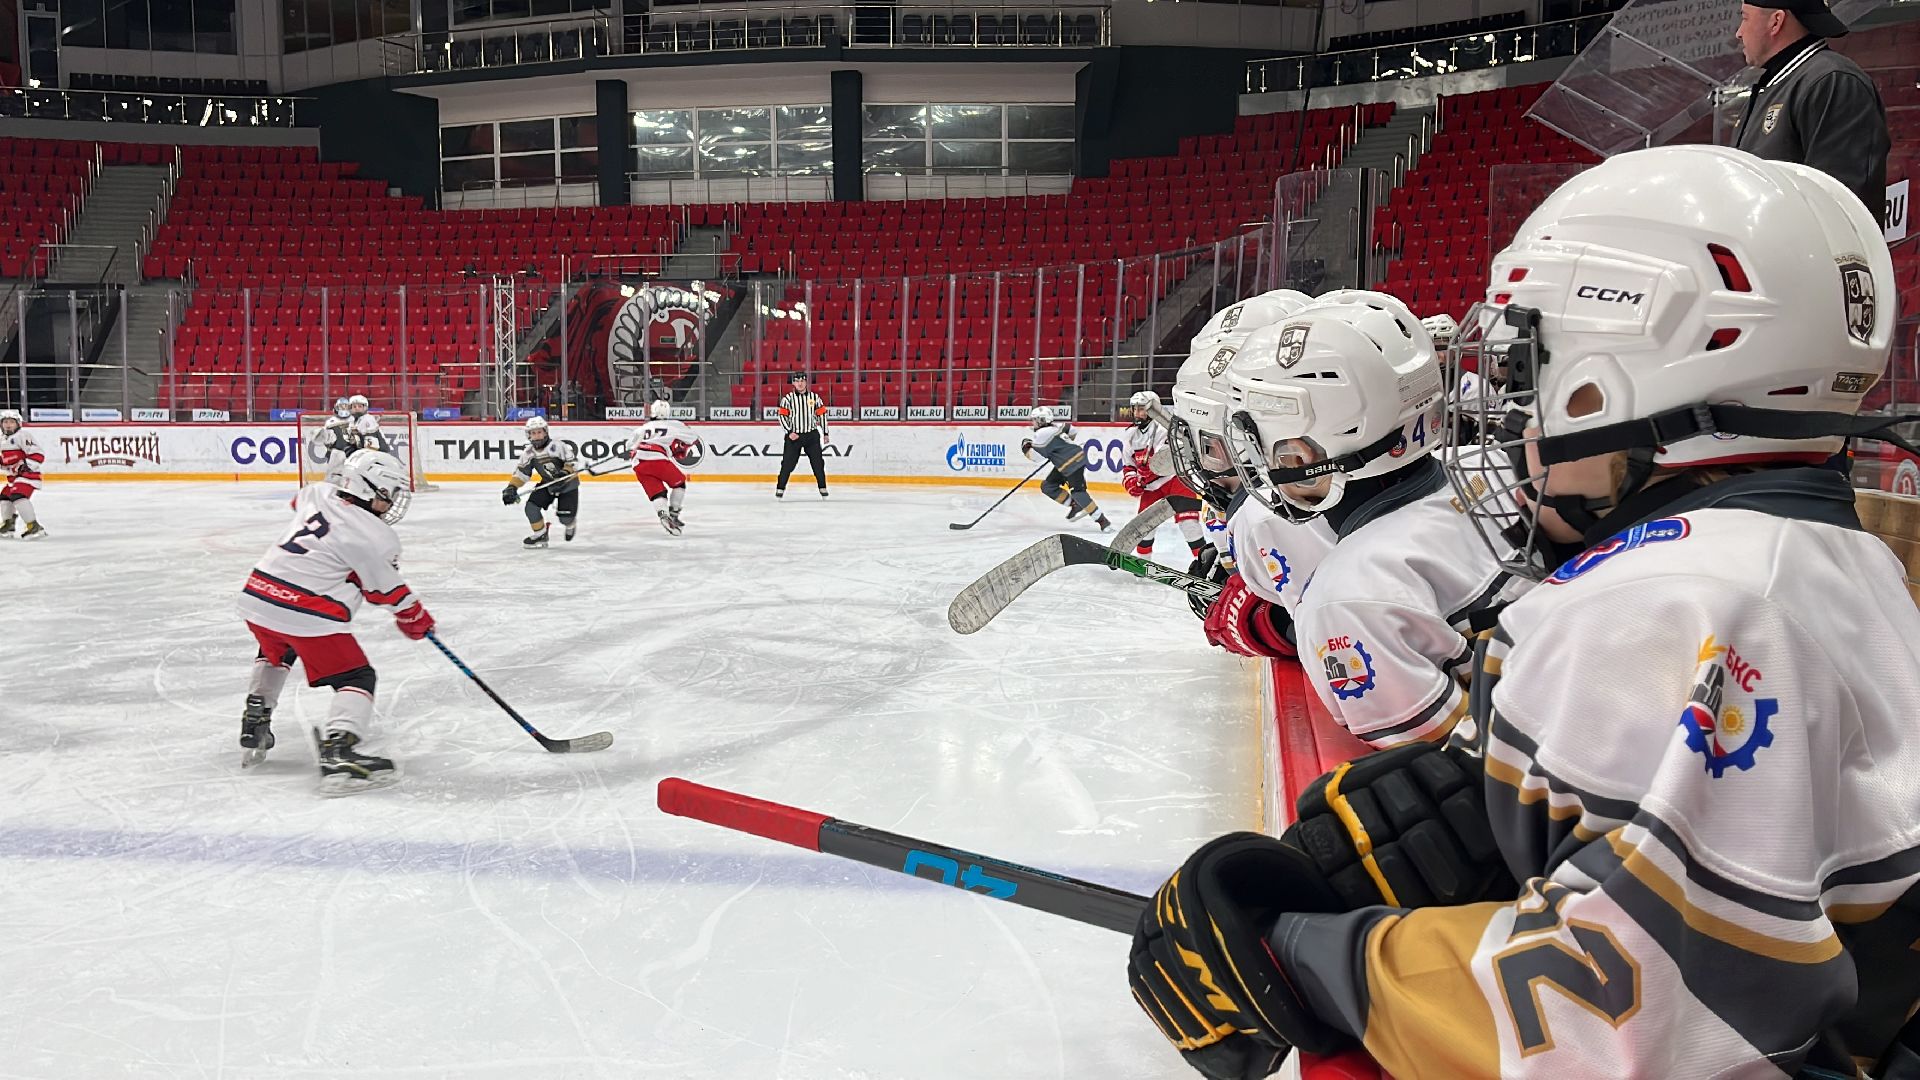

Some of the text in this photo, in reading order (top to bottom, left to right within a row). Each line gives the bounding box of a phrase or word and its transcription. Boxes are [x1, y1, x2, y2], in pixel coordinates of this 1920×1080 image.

[1577, 286, 1646, 305] CCM
[863, 409, 896, 417] KHL.RU
[909, 409, 942, 417] KHL.RU
[955, 409, 986, 417] KHL.RU
[1000, 408, 1030, 416] KHL.RU
[1191, 408, 1209, 417] CCM
[60, 432, 161, 465] ТУЛЬСКИЙ
[435, 438, 629, 461] ТИНЬОФФ
[966, 444, 1006, 457] ГАЗПРОМ
[279, 510, 330, 554] 2
[1327, 635, 1351, 651] БКС
[1725, 644, 1762, 693] БКС
